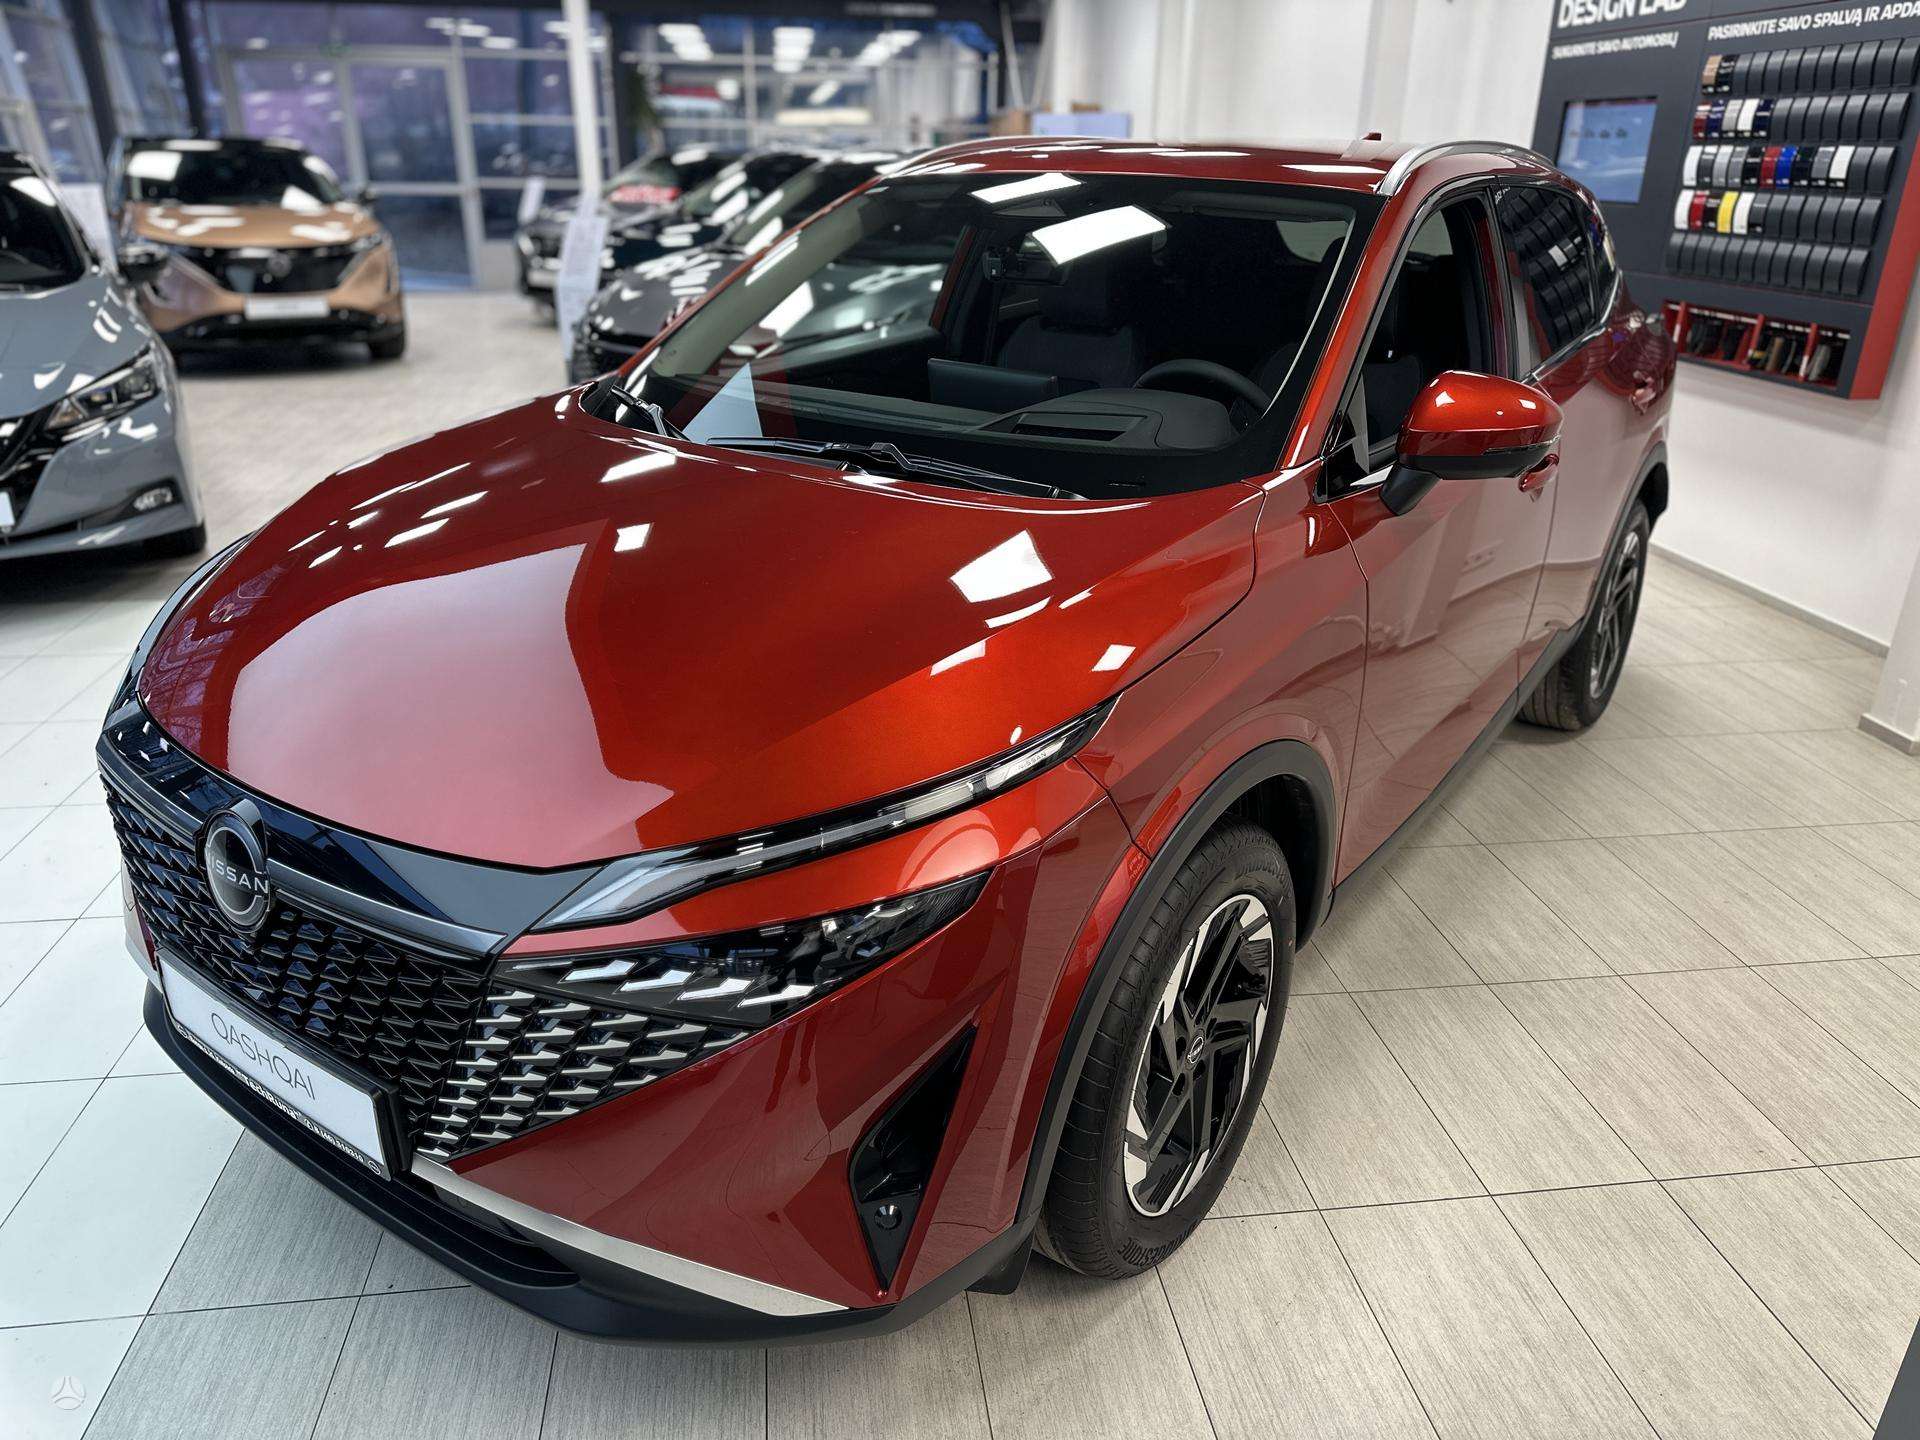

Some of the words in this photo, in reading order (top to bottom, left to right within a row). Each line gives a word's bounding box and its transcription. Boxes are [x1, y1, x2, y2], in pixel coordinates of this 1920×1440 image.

[1557, 0, 1637, 28] DESIGN
[1708, 19, 1777, 40] PASIRINKITE
[1777, 15, 1811, 32] SAVO
[1812, 8, 1862, 28] SPALVĄ
[1863, 6, 1880, 23] IR
[211, 1013, 315, 1100] QASHQAI
